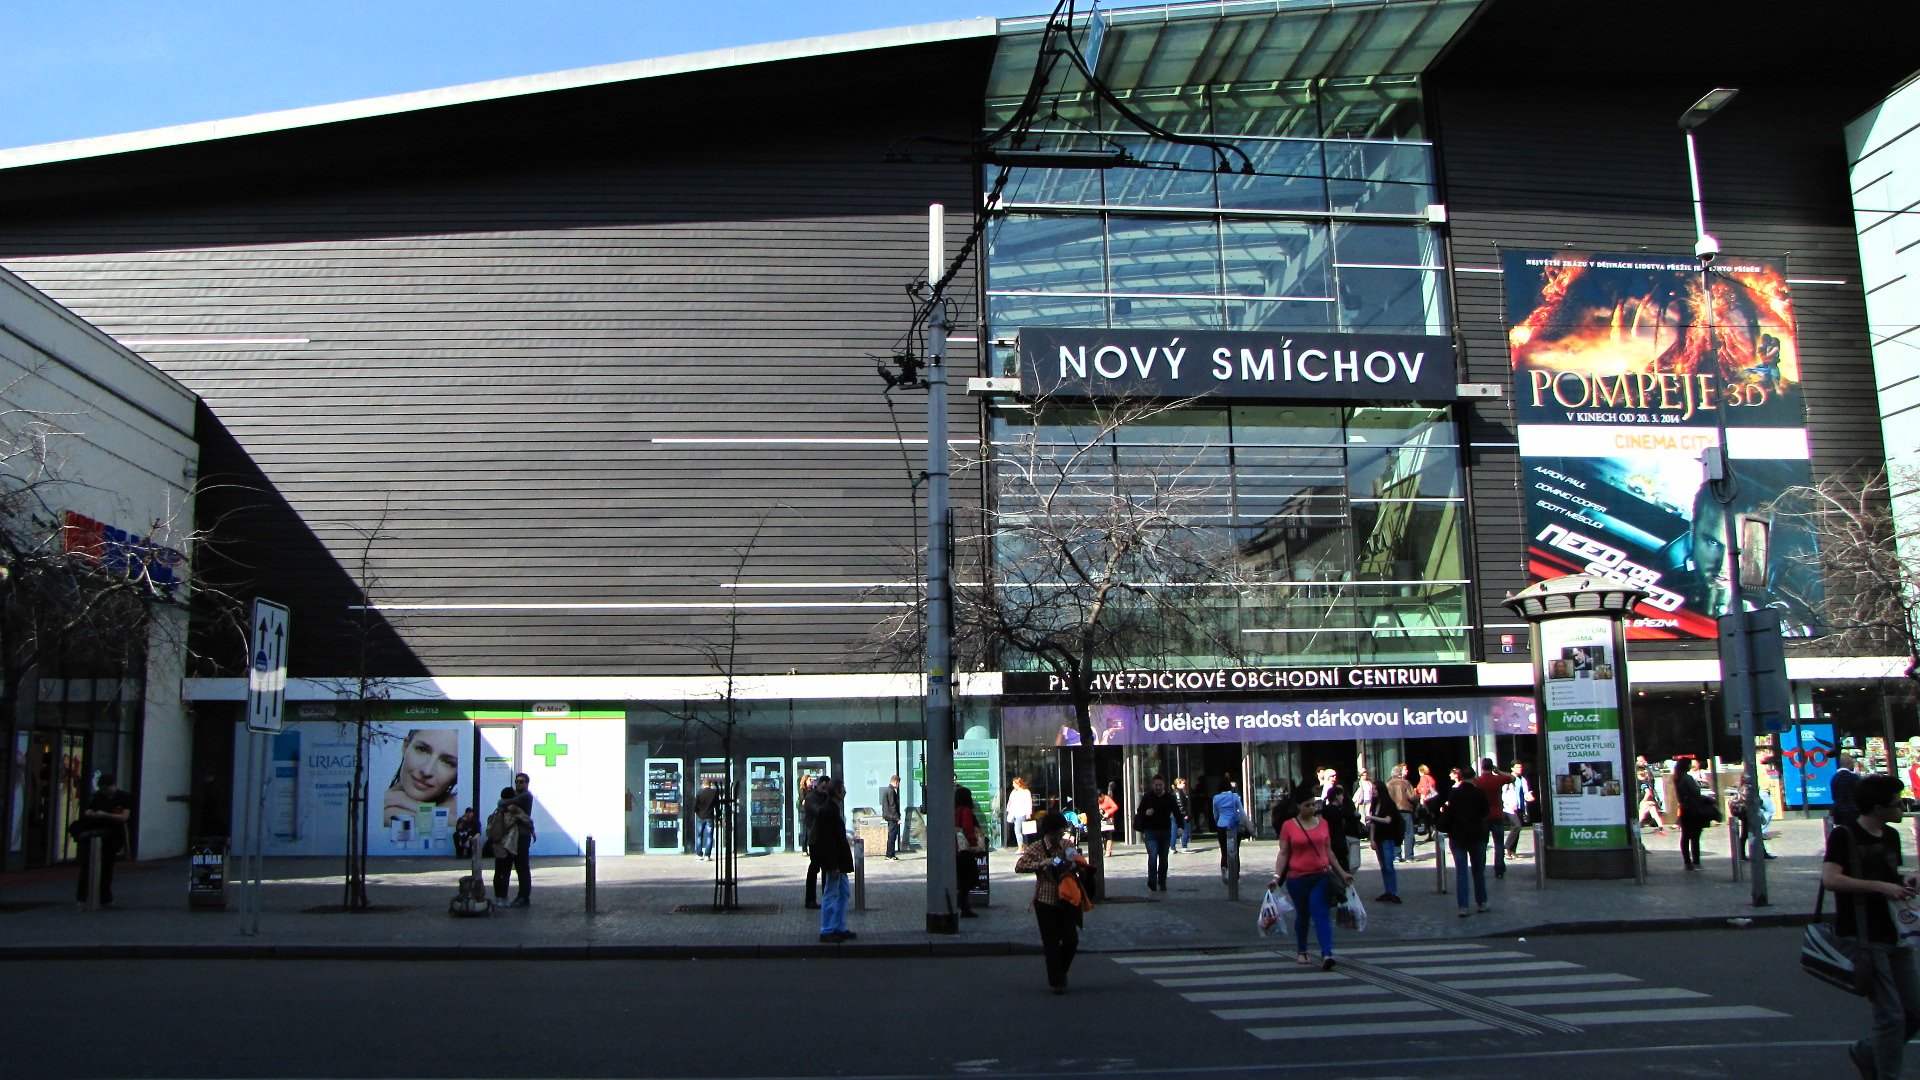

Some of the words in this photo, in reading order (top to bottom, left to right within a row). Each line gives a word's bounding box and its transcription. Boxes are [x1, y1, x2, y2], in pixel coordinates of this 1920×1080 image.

[1589, 260, 1596, 269] V
[1635, 261, 1665, 271] LIDSTVA
[1059, 337, 1187, 381] NOVÝ
[1212, 338, 1425, 384] SMÍCHOV
[1528, 369, 1718, 421] POMPEJE
[1727, 383, 1768, 407] 3D
[1566, 412, 1574, 422] V
[1577, 412, 1617, 422] KINECH
[1619, 413, 1634, 423] OD
[1637, 413, 1649, 423] 20.
[1651, 414, 1659, 423] 3.
[1661, 414, 1680, 424] 2014
[1615, 434, 1677, 449] CINEMA
[1533, 466, 1566, 482] AARON
[1564, 476, 1587, 490] PAUL
[1535, 482, 1572, 501] DOMINIC
[1571, 493, 1607, 514] COOPER
[1536, 500, 1566, 516] SCOTT
[1565, 509, 1605, 530] MESCUDI
[1535, 523, 1628, 569] NEED
[1615, 559, 1663, 586] FOR
[1633, 617, 1679, 628] BŘEZNA
[1050, 669, 1226, 691] PHVĚZDIČKOVÉ
[1231, 668, 1339, 688] OBCHODNÍ
[1348, 668, 1438, 686] CENTRUM
[1144, 712, 1230, 734] Udělejte
[1235, 709, 1301, 730] radost
[1306, 708, 1399, 728] dárkovou
[1403, 708, 1468, 725] kartou
[1562, 711, 1601, 724] ivio.cz
[1564, 734, 1601, 743] SPOUSTY
[1567, 750, 1601, 758] ZDARMA
[1570, 828, 1608, 840] ivio.cz
